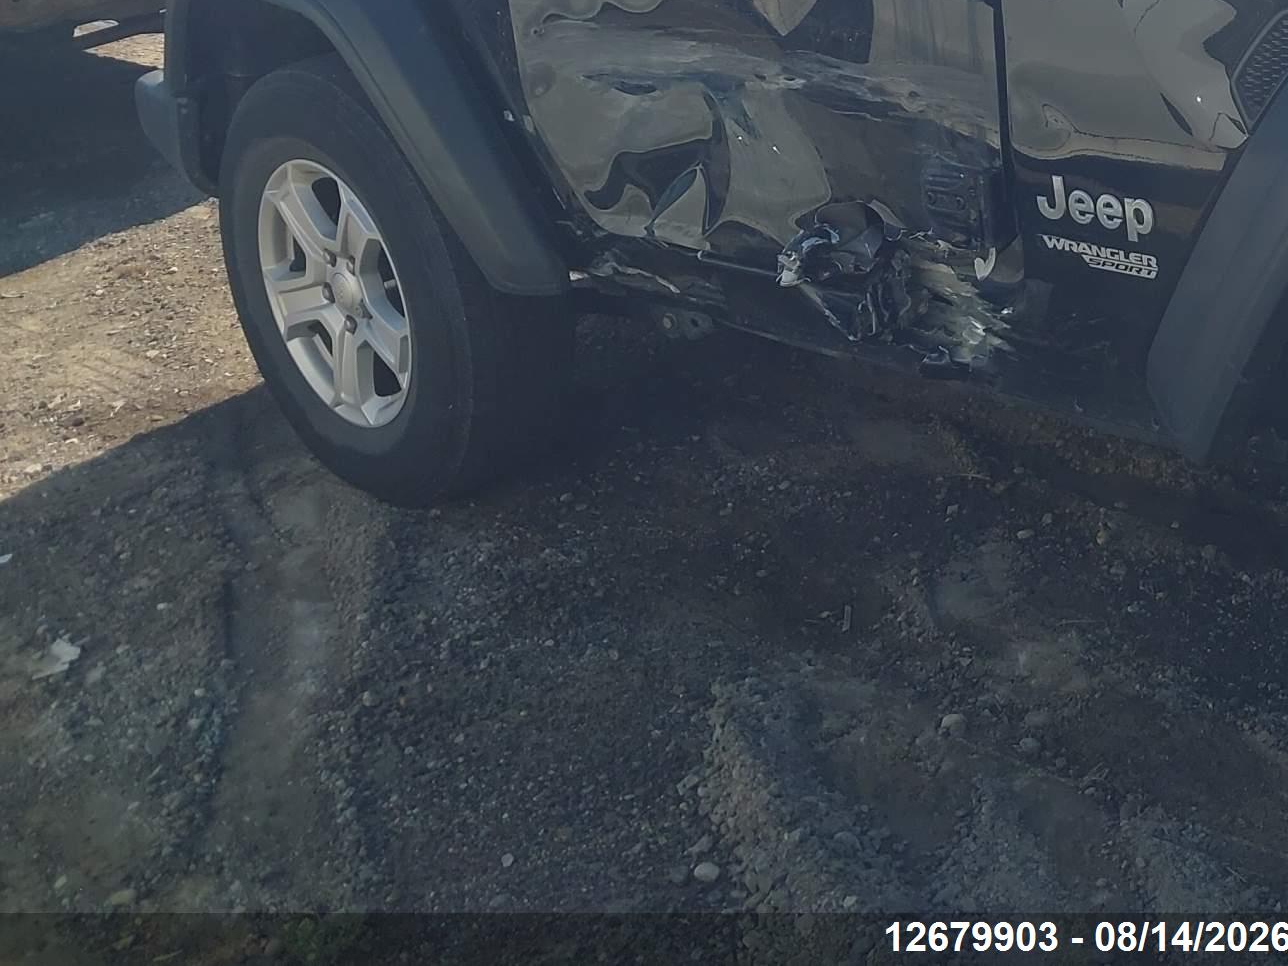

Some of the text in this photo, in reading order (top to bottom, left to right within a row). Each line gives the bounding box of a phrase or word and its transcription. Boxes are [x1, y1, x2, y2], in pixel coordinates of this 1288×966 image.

[1037, 175, 1154, 242] Jeep
[1041, 234, 1158, 268] WRANGLER
[1086, 257, 1157, 277] SPORT
